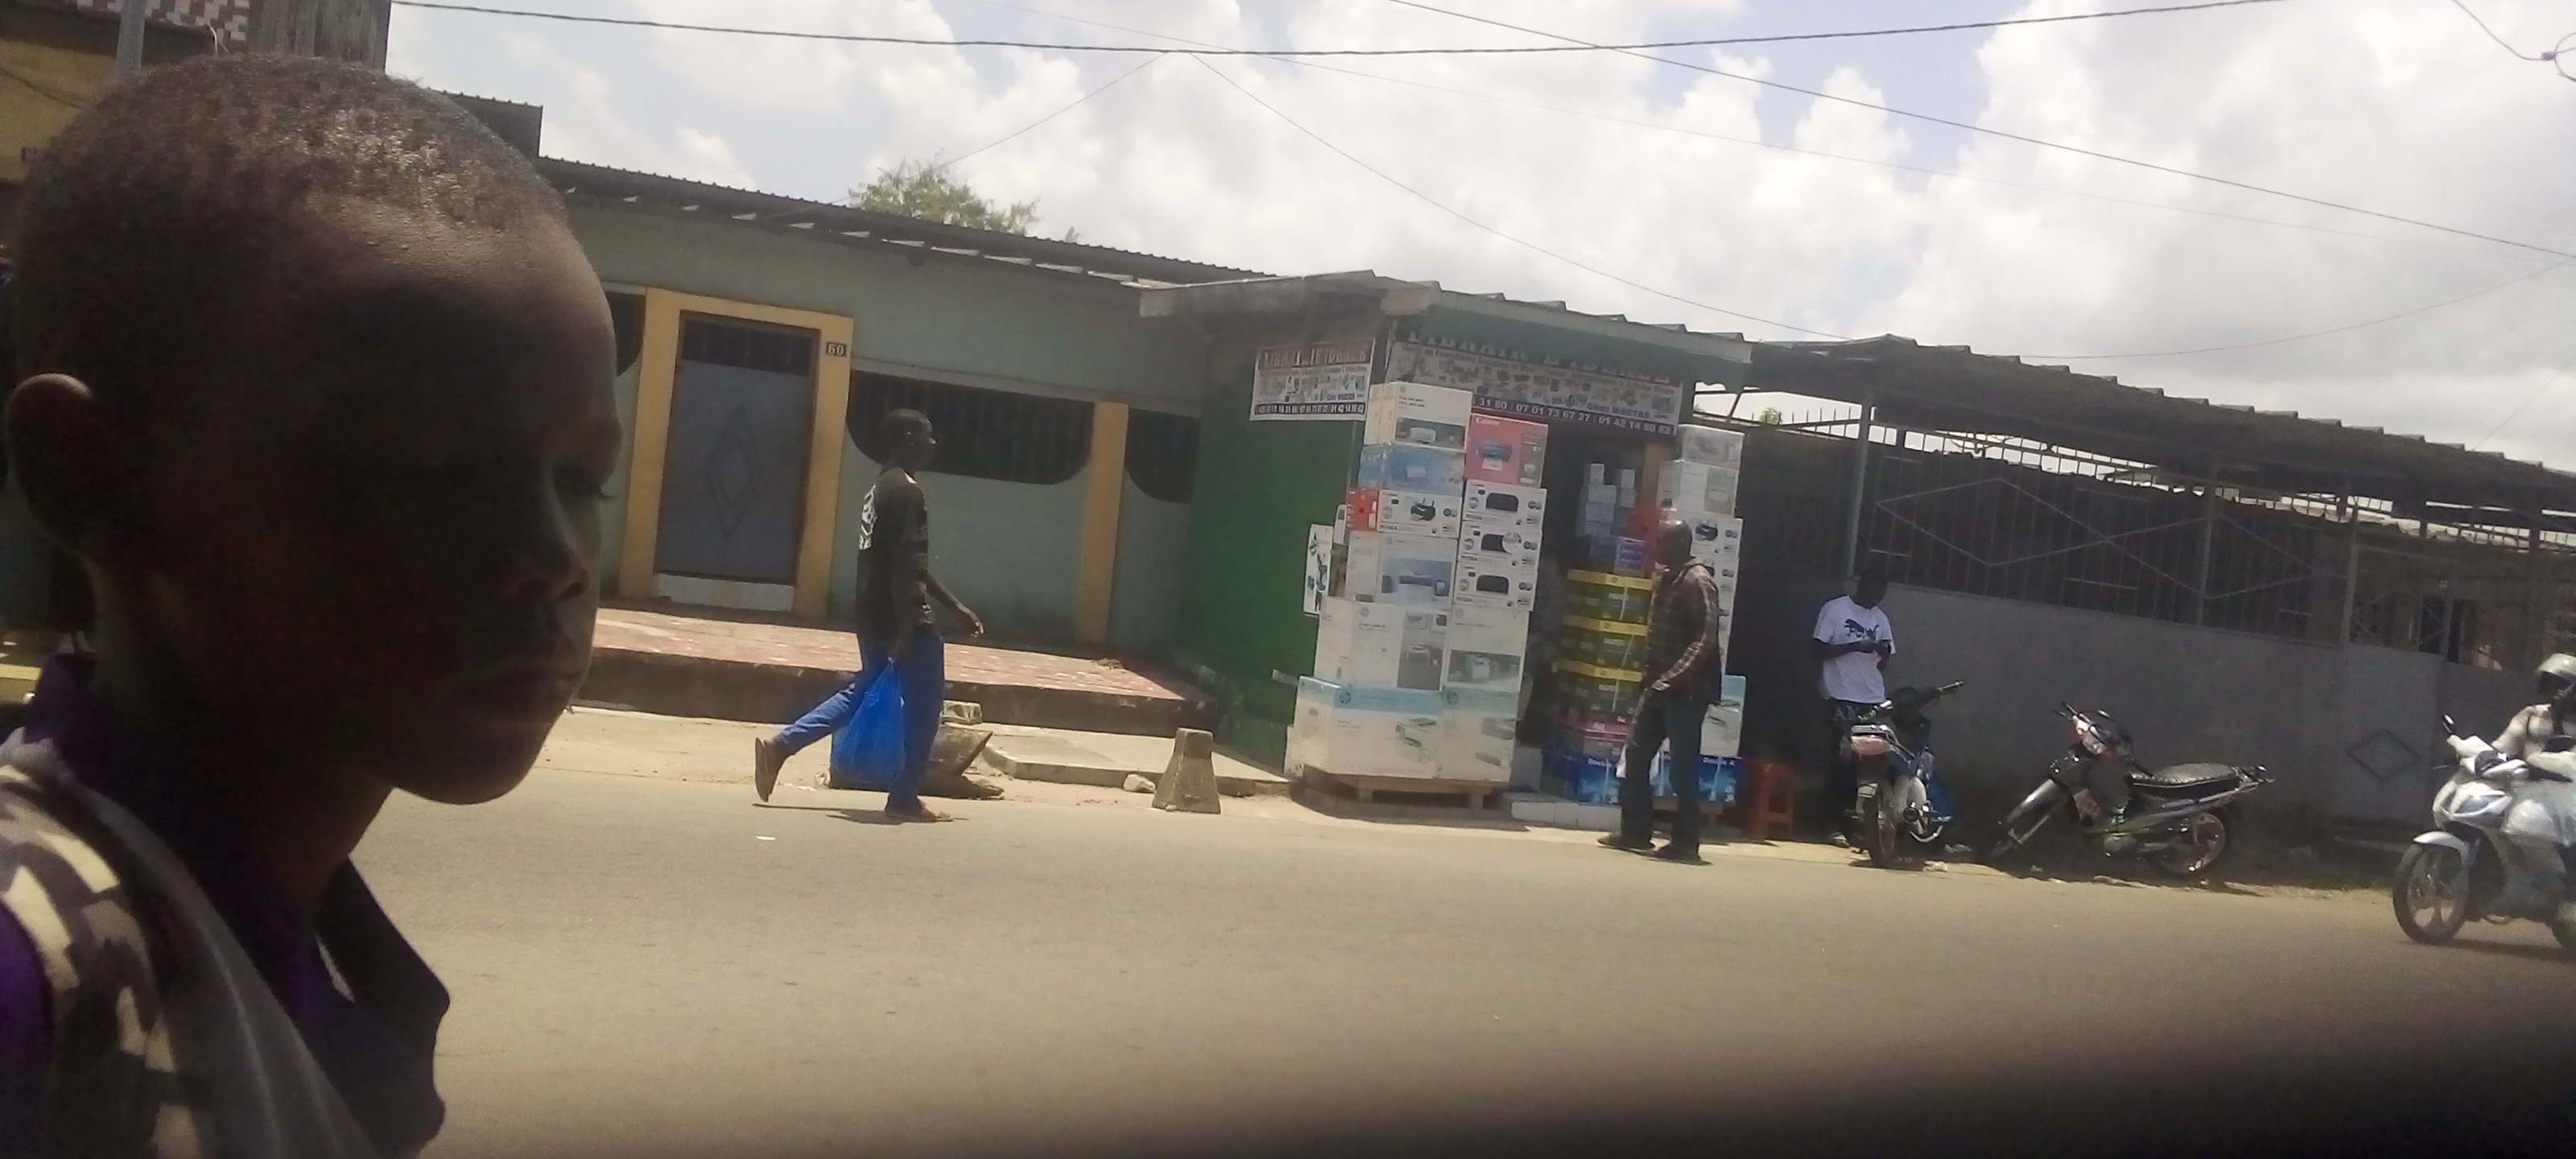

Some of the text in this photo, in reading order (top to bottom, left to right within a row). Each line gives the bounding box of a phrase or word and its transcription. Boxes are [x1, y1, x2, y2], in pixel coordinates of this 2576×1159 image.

[828, 343, 844, 356] 60
[1516, 403, 1529, 413] 07
[1531, 406, 1544, 415] 01
[1547, 408, 1560, 418] 73
[1578, 413, 1591, 423] 27
[1599, 415, 1610, 425] 01
[1613, 418, 1626, 428] 42
[1629, 421, 1641, 430] 14
